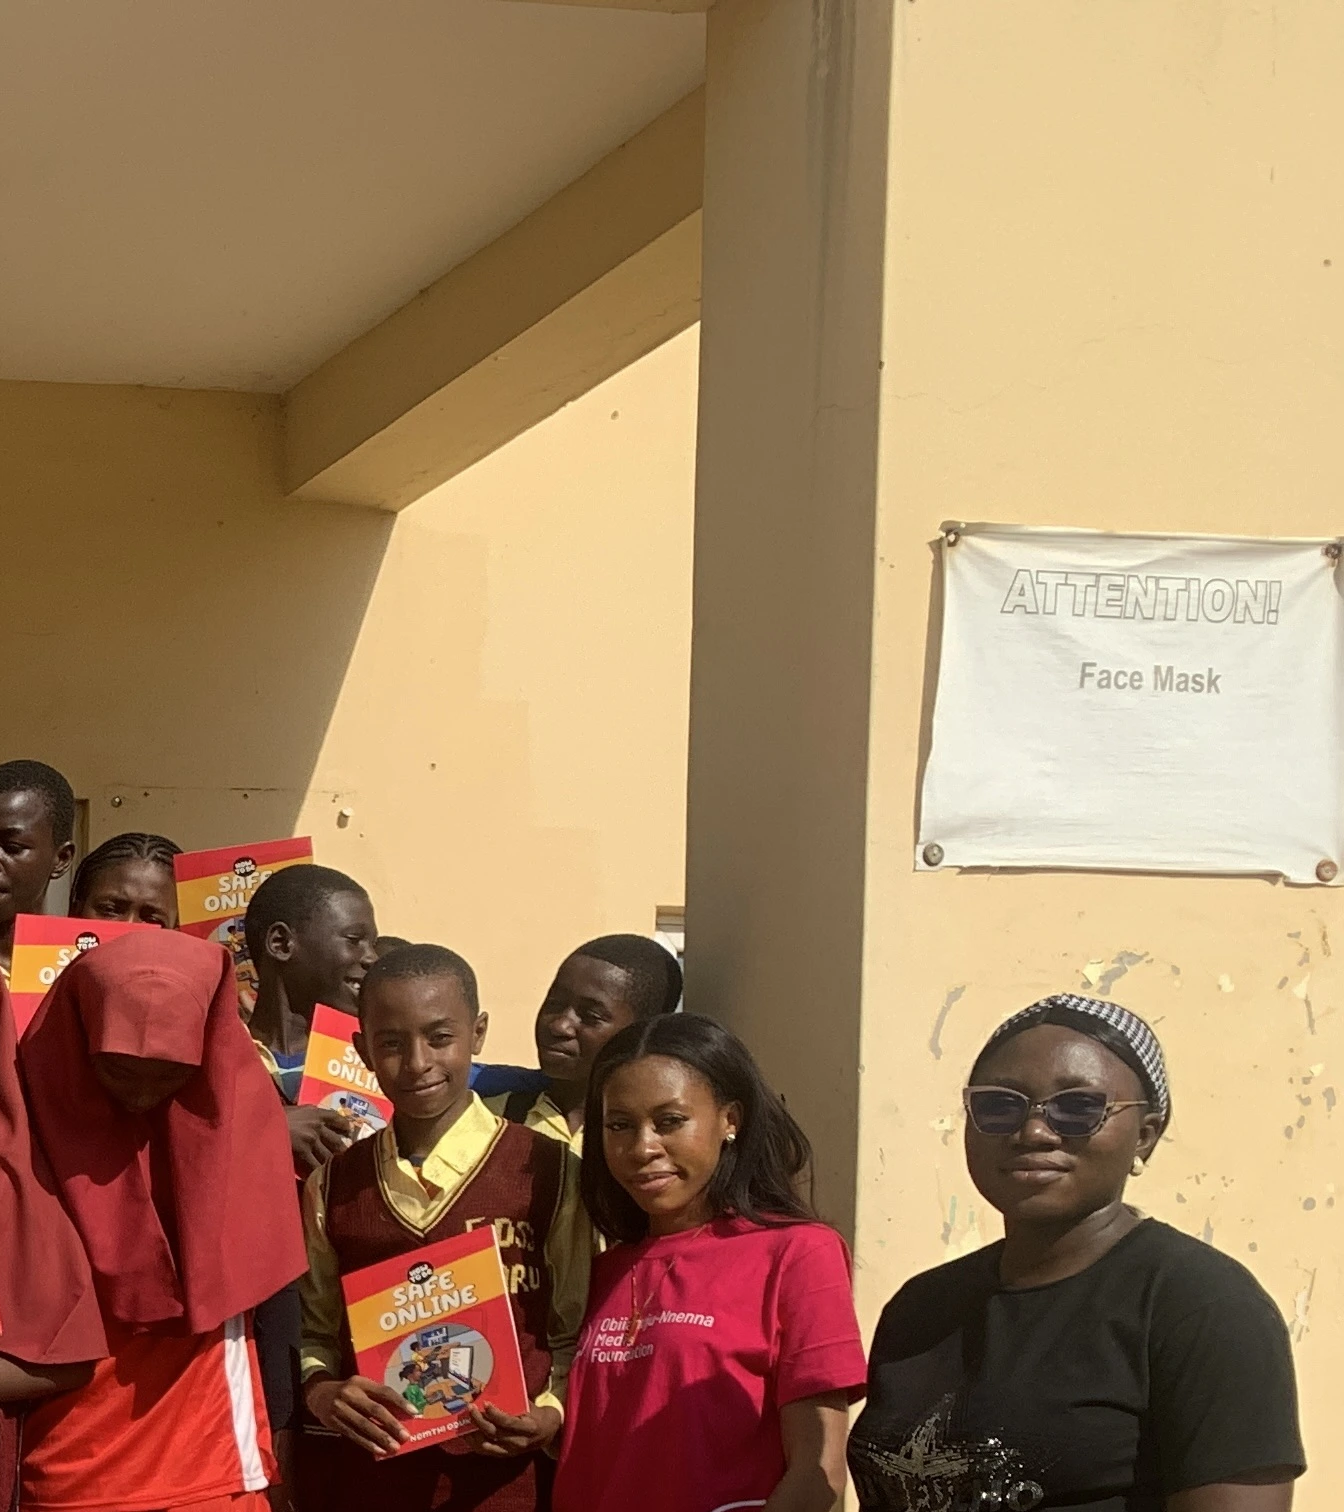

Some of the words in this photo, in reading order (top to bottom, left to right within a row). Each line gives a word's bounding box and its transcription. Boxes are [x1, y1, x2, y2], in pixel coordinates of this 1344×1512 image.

[1000, 568, 1282, 625] ATTENTION!
[1078, 661, 1144, 691] Face
[1152, 664, 1222, 694] Mask
[204, 893, 253, 912] ONL
[392, 1270, 455, 1307] SAFE
[379, 1284, 479, 1331] ONLINE
